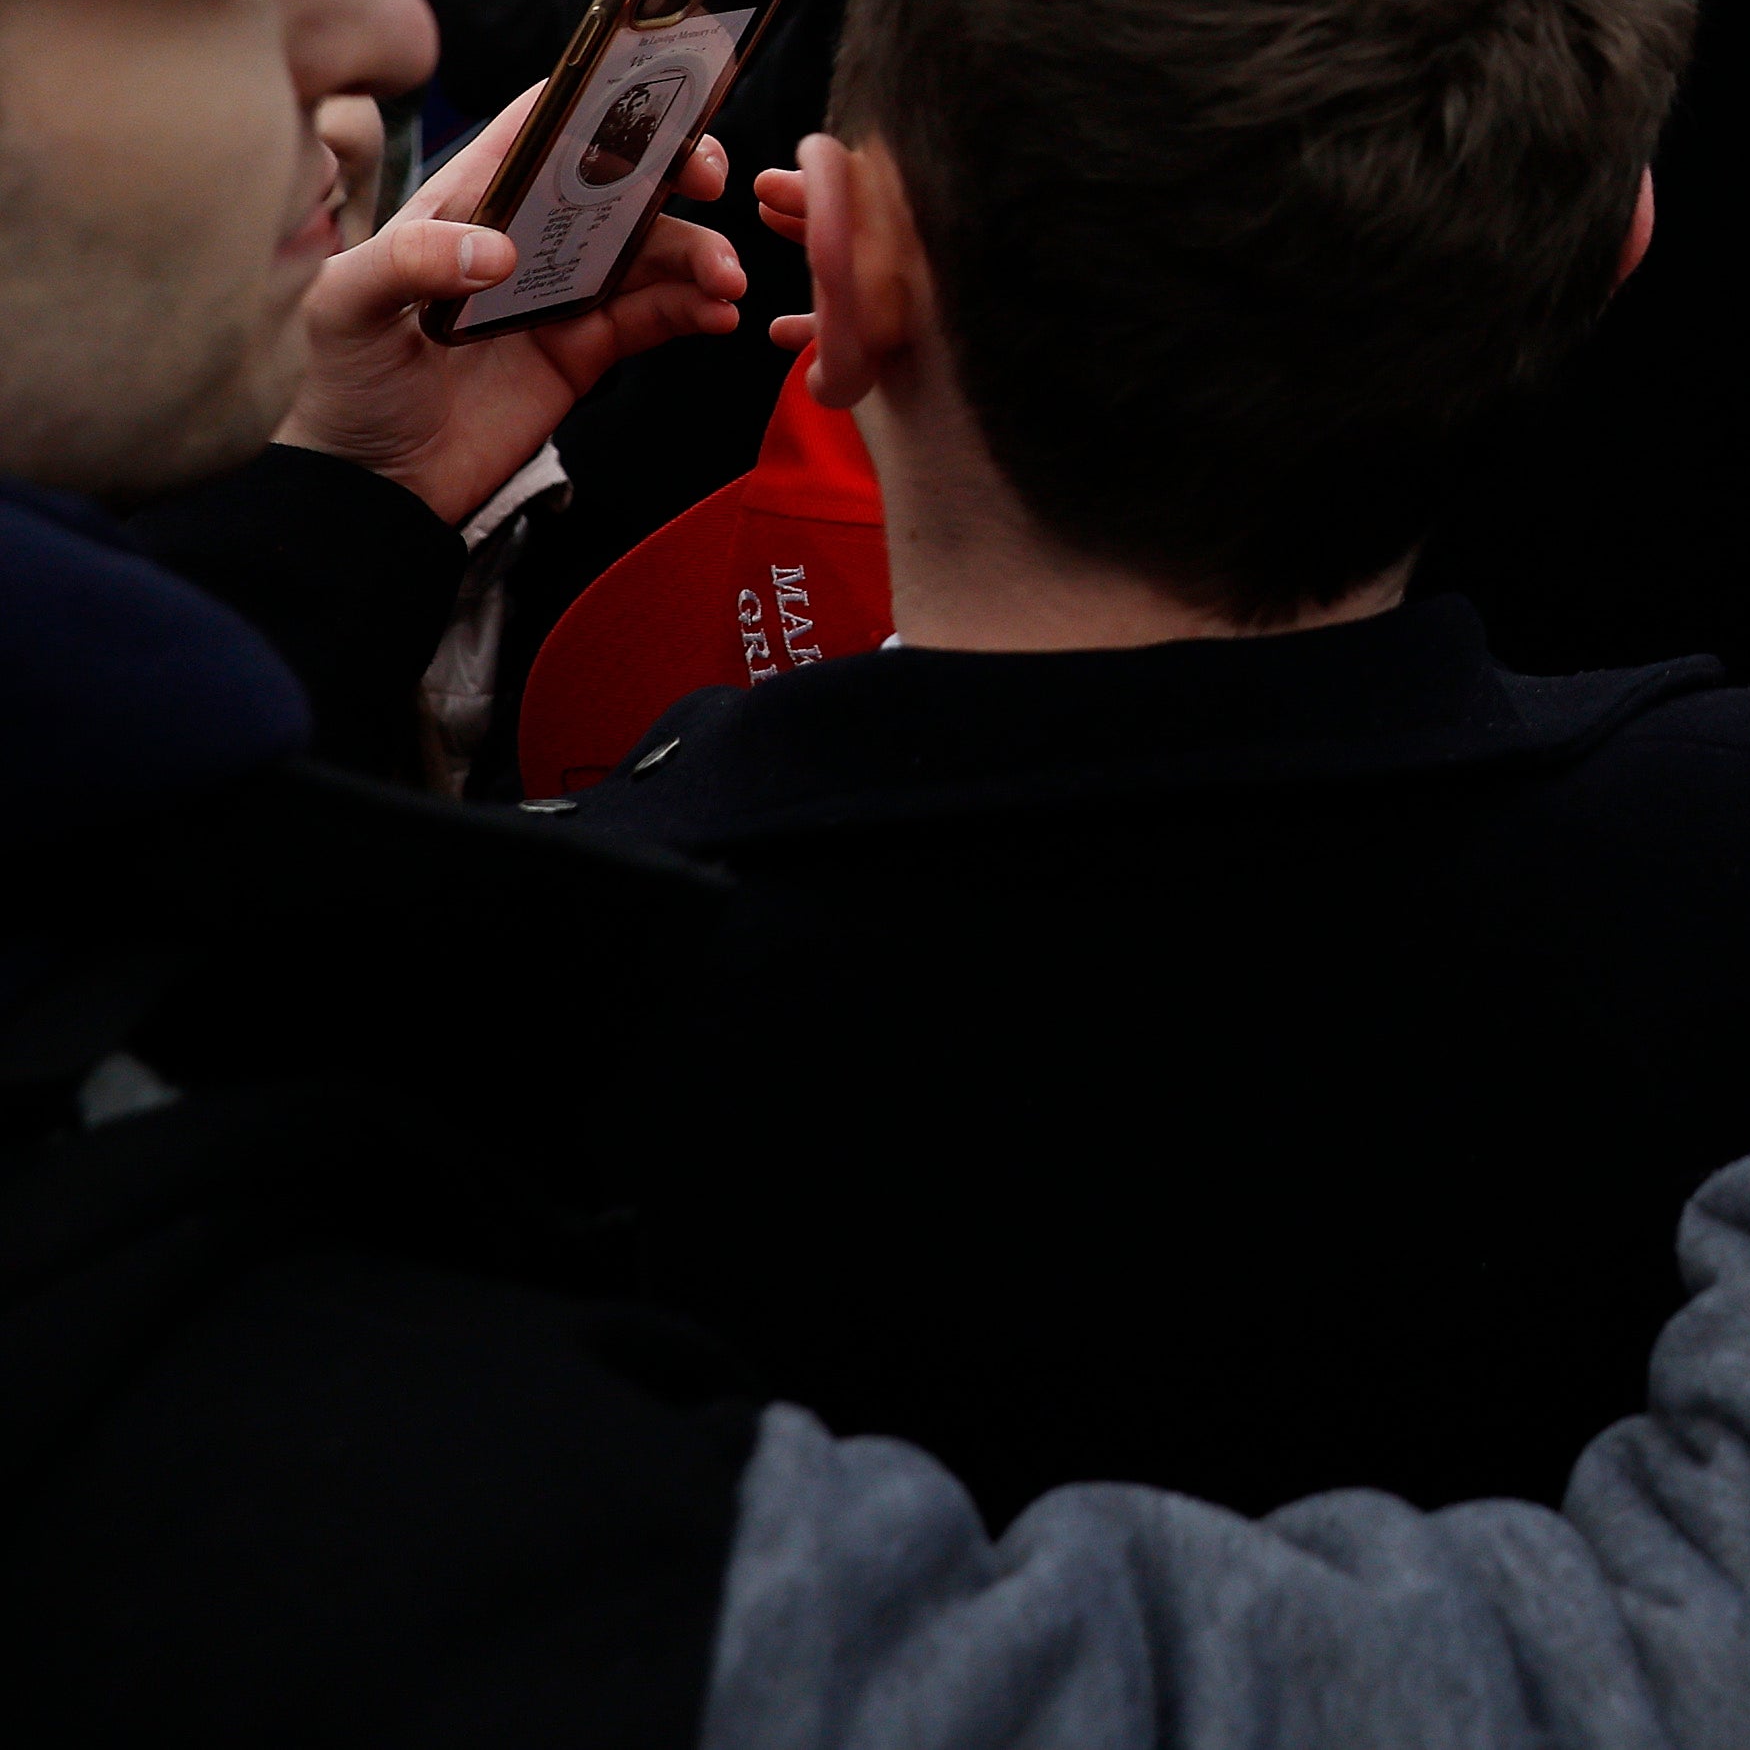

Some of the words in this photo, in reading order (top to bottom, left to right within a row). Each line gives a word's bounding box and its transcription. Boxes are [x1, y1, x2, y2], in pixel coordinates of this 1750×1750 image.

[648, 32, 677, 46] Loving
[677, 27, 710, 41] Memory
[770, 564, 823, 667] MAK
